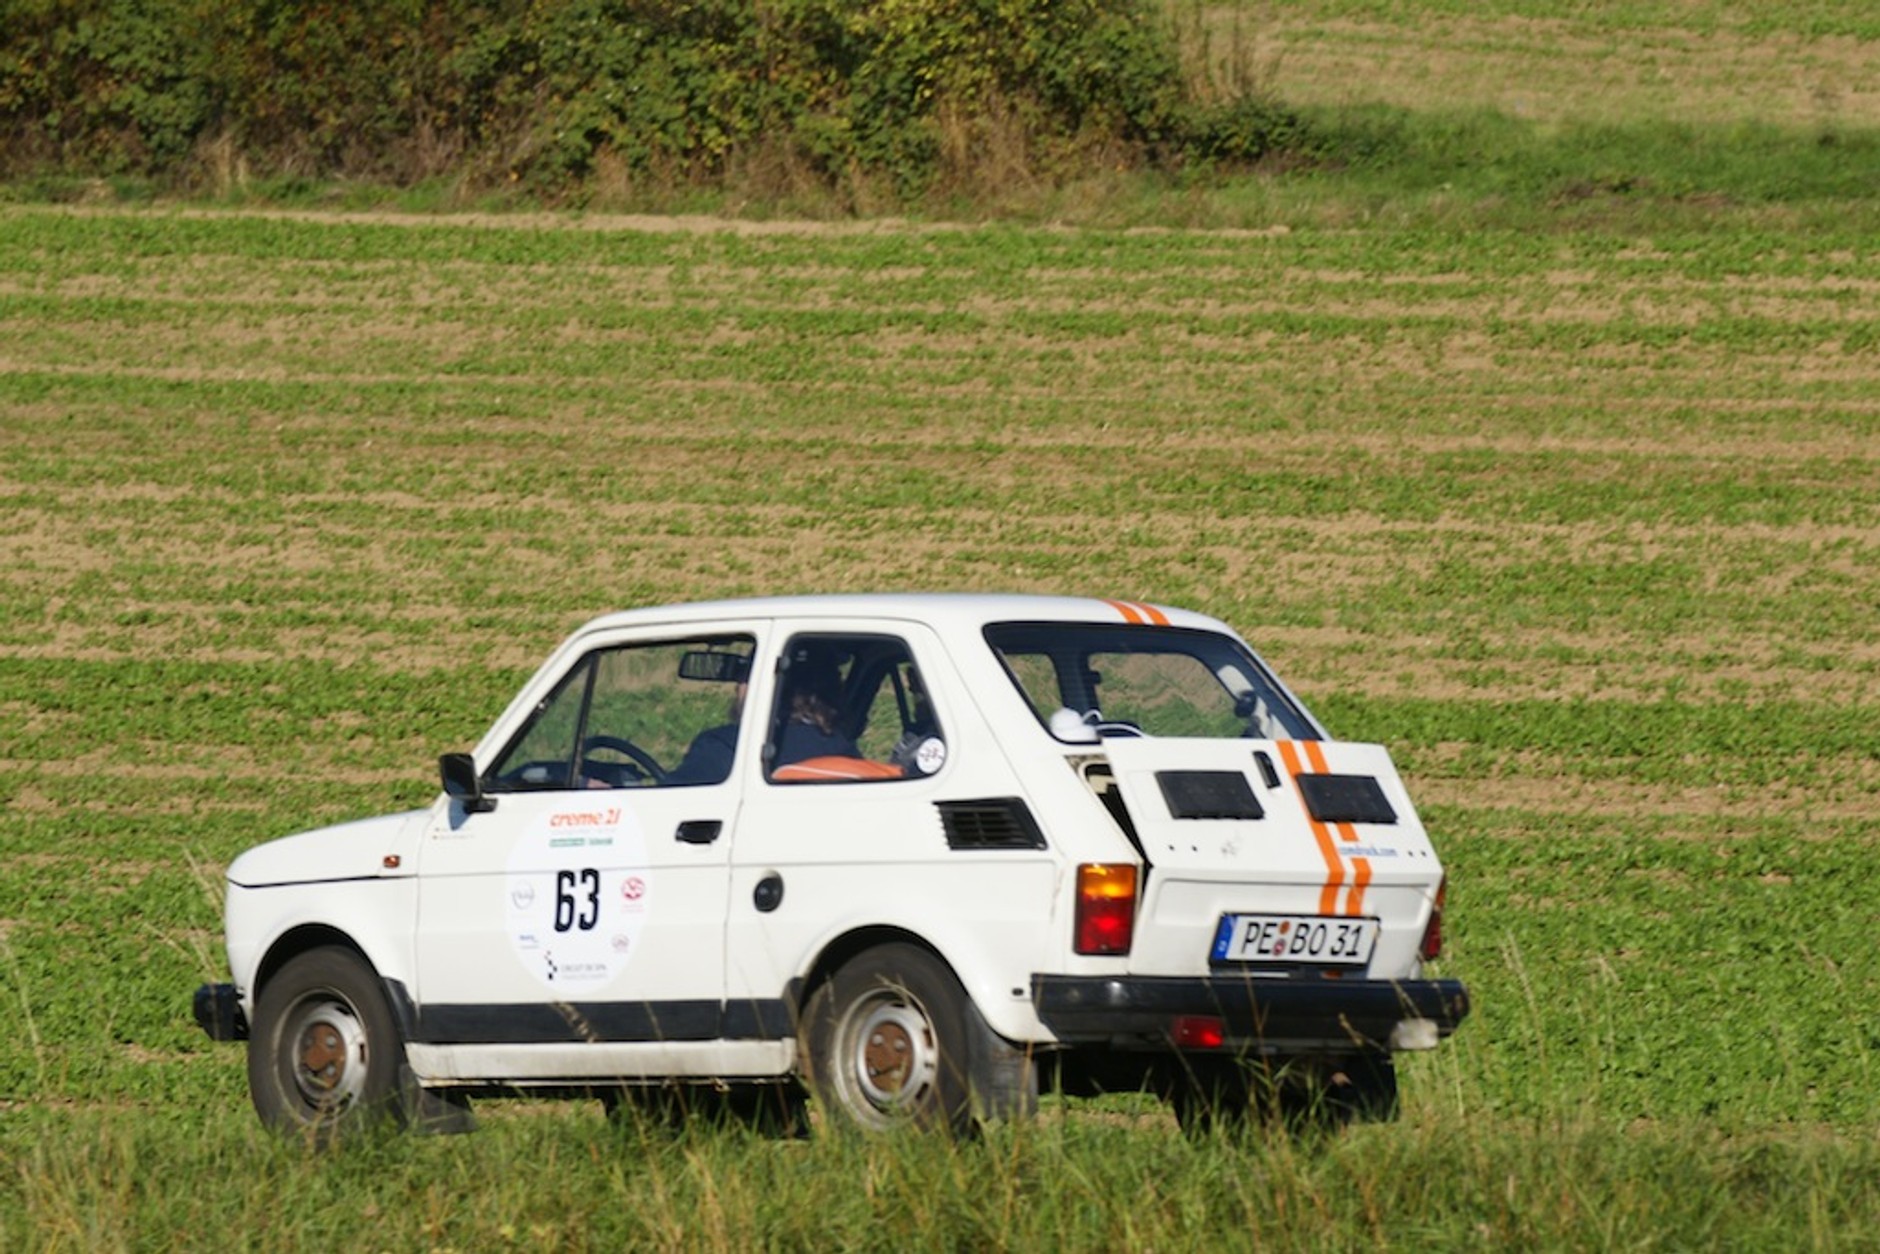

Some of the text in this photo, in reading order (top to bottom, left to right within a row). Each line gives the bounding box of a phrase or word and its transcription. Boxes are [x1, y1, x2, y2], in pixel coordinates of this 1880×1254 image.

[549, 812, 603, 827] creme
[554, 867, 600, 932] 63
[1242, 922, 1362, 957] PE BO 31
